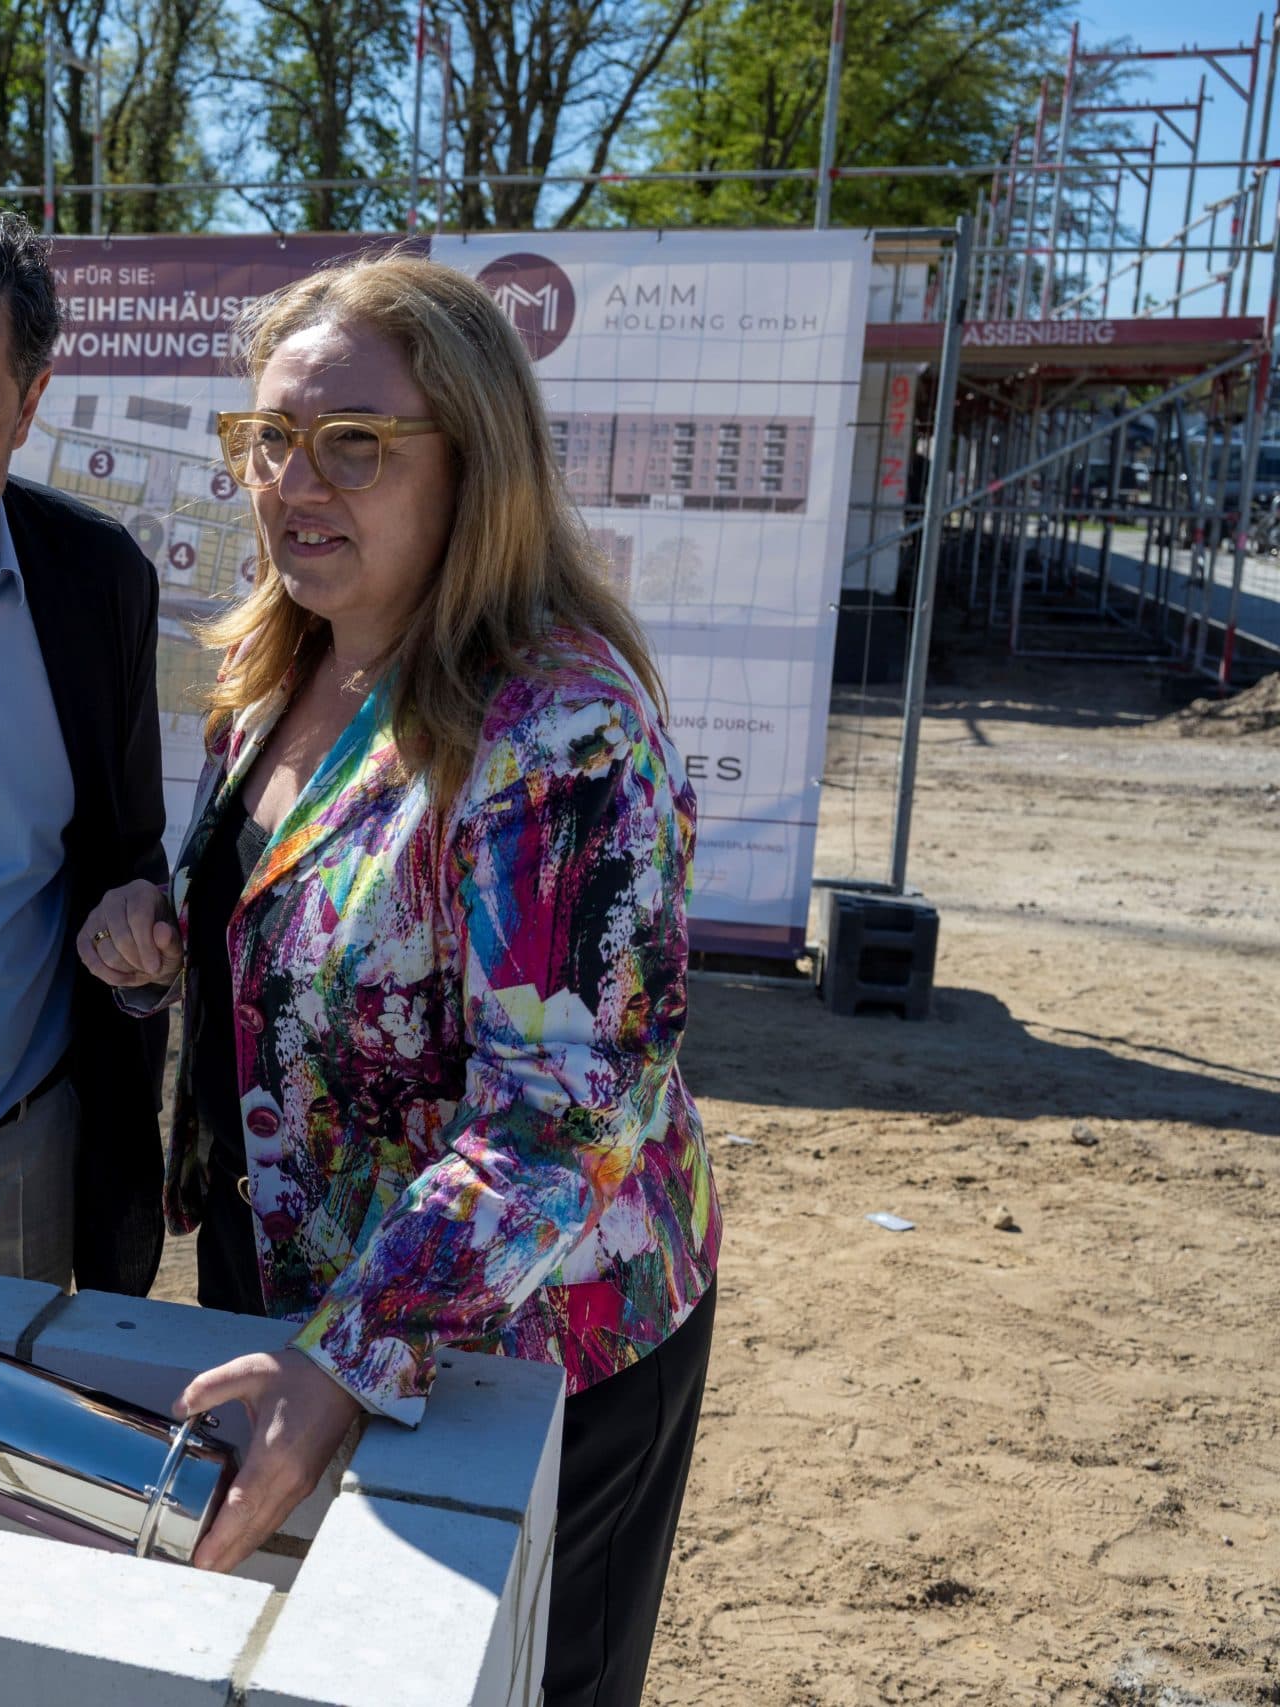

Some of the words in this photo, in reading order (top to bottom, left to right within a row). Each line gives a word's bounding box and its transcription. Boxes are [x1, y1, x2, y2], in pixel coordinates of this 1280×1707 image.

[74, 265, 112, 285] FÜR
[118, 267, 155, 285] SIE:
[605, 284, 698, 307] AMM
[605, 314, 725, 331] HOLDING
[738, 313, 818, 331] GmbH
[95, 455, 109, 474] 3
[216, 476, 231, 495] 3
[173, 546, 189, 566] 4
[670, 715, 708, 730] UNG
[713, 717, 776, 734] DURCH:
